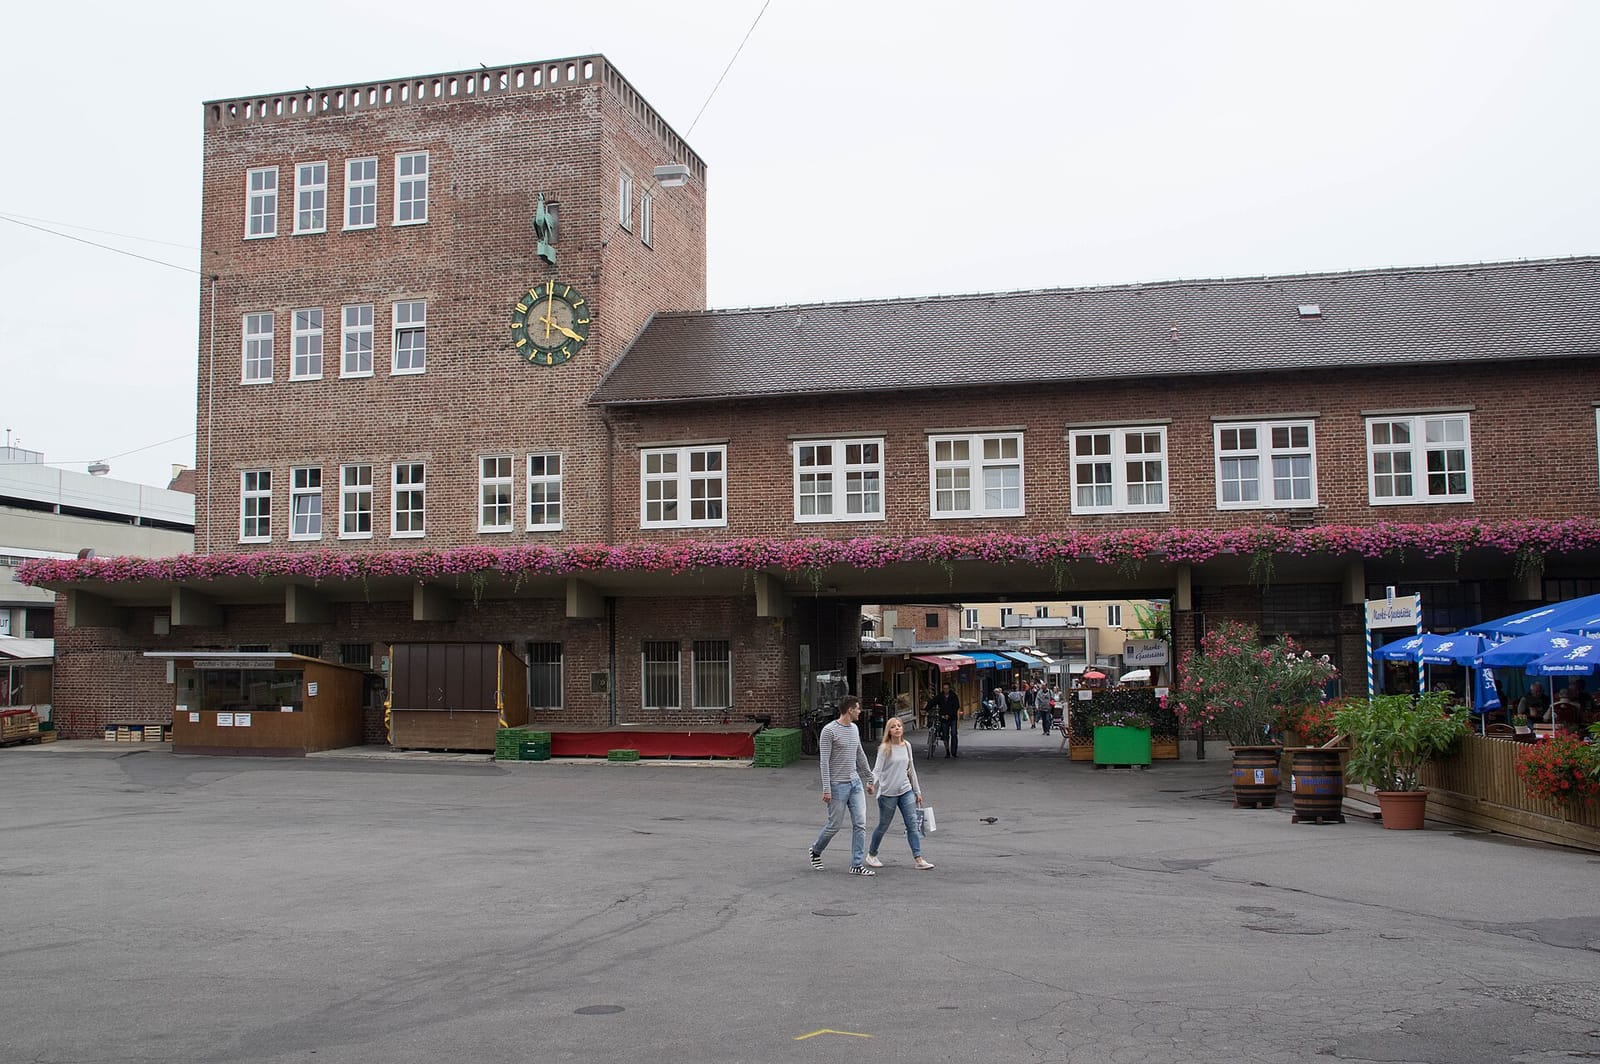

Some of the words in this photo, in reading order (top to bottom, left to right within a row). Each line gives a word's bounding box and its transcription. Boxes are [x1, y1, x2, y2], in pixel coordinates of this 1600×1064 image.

[529, 288, 539, 300] 11
[515, 303, 528, 314] 10
[573, 298, 585, 309] 2
[528, 349, 538, 361] 7
[547, 352, 553, 365] 6
[562, 346, 571, 359] 5
